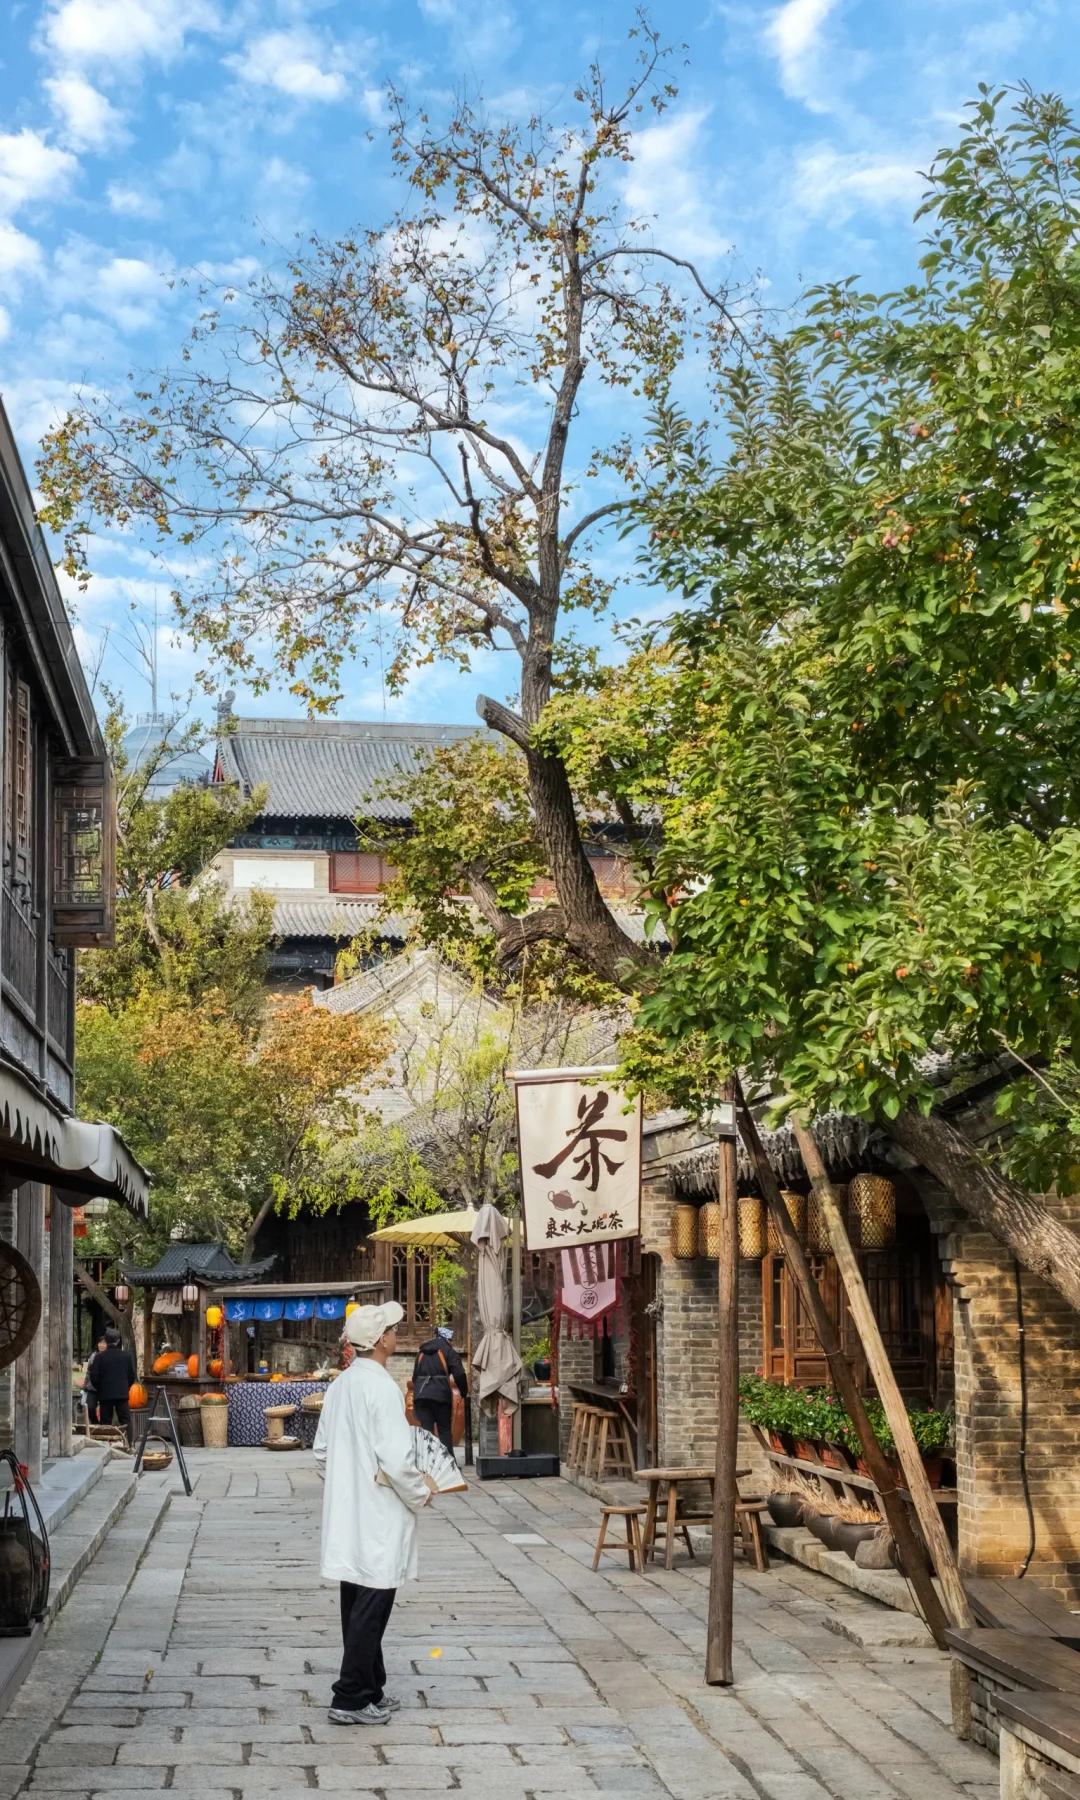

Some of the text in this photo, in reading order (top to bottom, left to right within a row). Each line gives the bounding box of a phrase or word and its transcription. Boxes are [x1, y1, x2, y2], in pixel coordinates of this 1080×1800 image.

[532, 1090, 628, 1192] 茶
[545, 1210, 623, 1239] 泉水大碗茶
